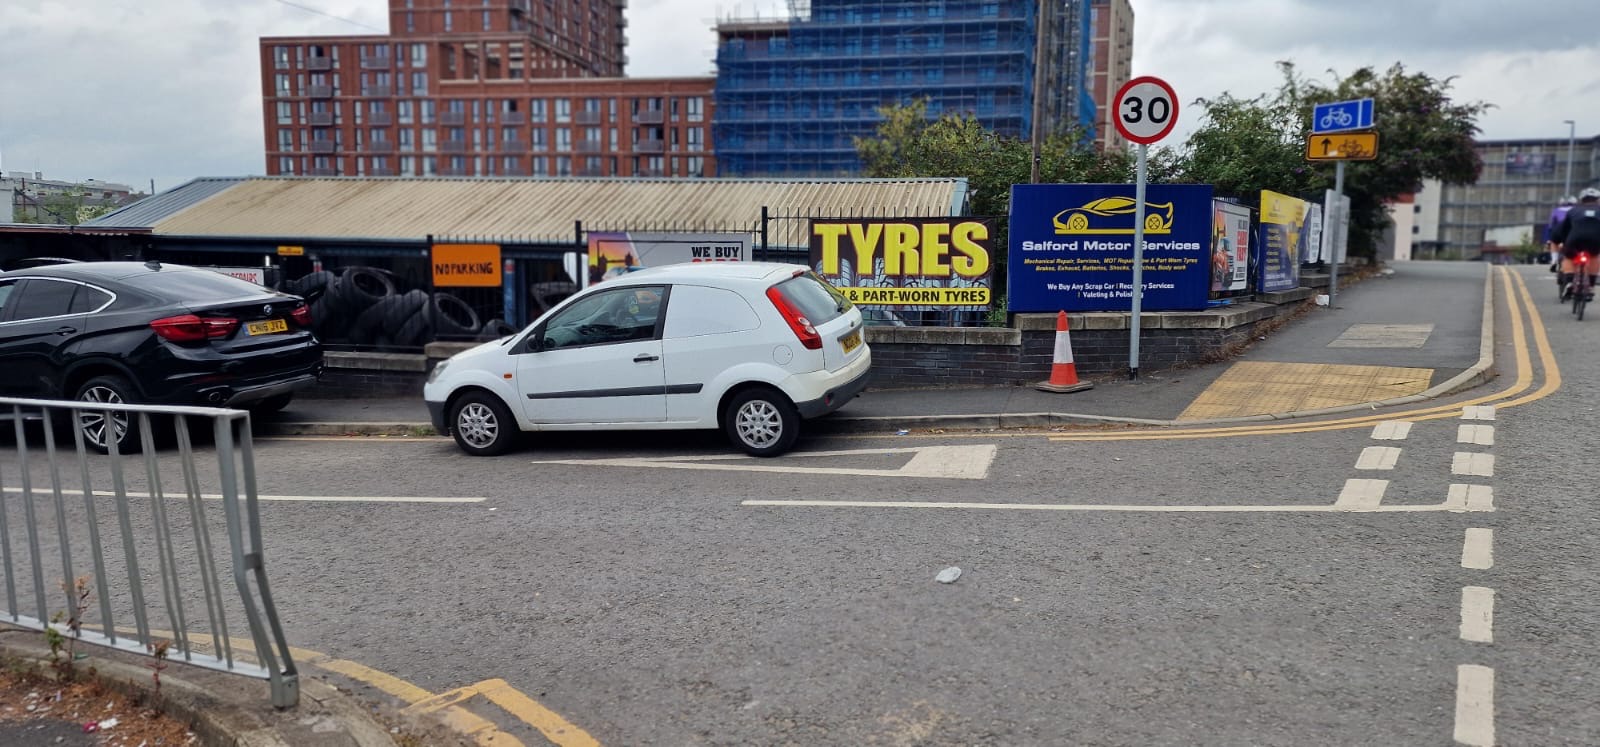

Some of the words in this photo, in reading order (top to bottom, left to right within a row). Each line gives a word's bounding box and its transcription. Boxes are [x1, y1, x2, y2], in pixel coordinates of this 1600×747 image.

[1123, 96, 1170, 124] 30
[813, 222, 989, 277] TYRES
[1022, 241, 1078, 251] Salford
[1083, 241, 1131, 251] Motor
[1142, 240, 1200, 250] Services
[691, 246, 711, 258] WE
[715, 246, 740, 258] BUY
[435, 263, 451, 275] NO
[451, 262, 493, 274] PARKING
[1058, 283, 1071, 291] Buy
[1071, 283, 1084, 291] Any
[1084, 283, 1103, 291] Scrap
[1119, 282, 1148, 290] Recory
[850, 290, 859, 301] &
[862, 290, 940, 302] PART-WORN
[945, 290, 986, 302] TYRES
[1083, 291, 1108, 299] Valeting
